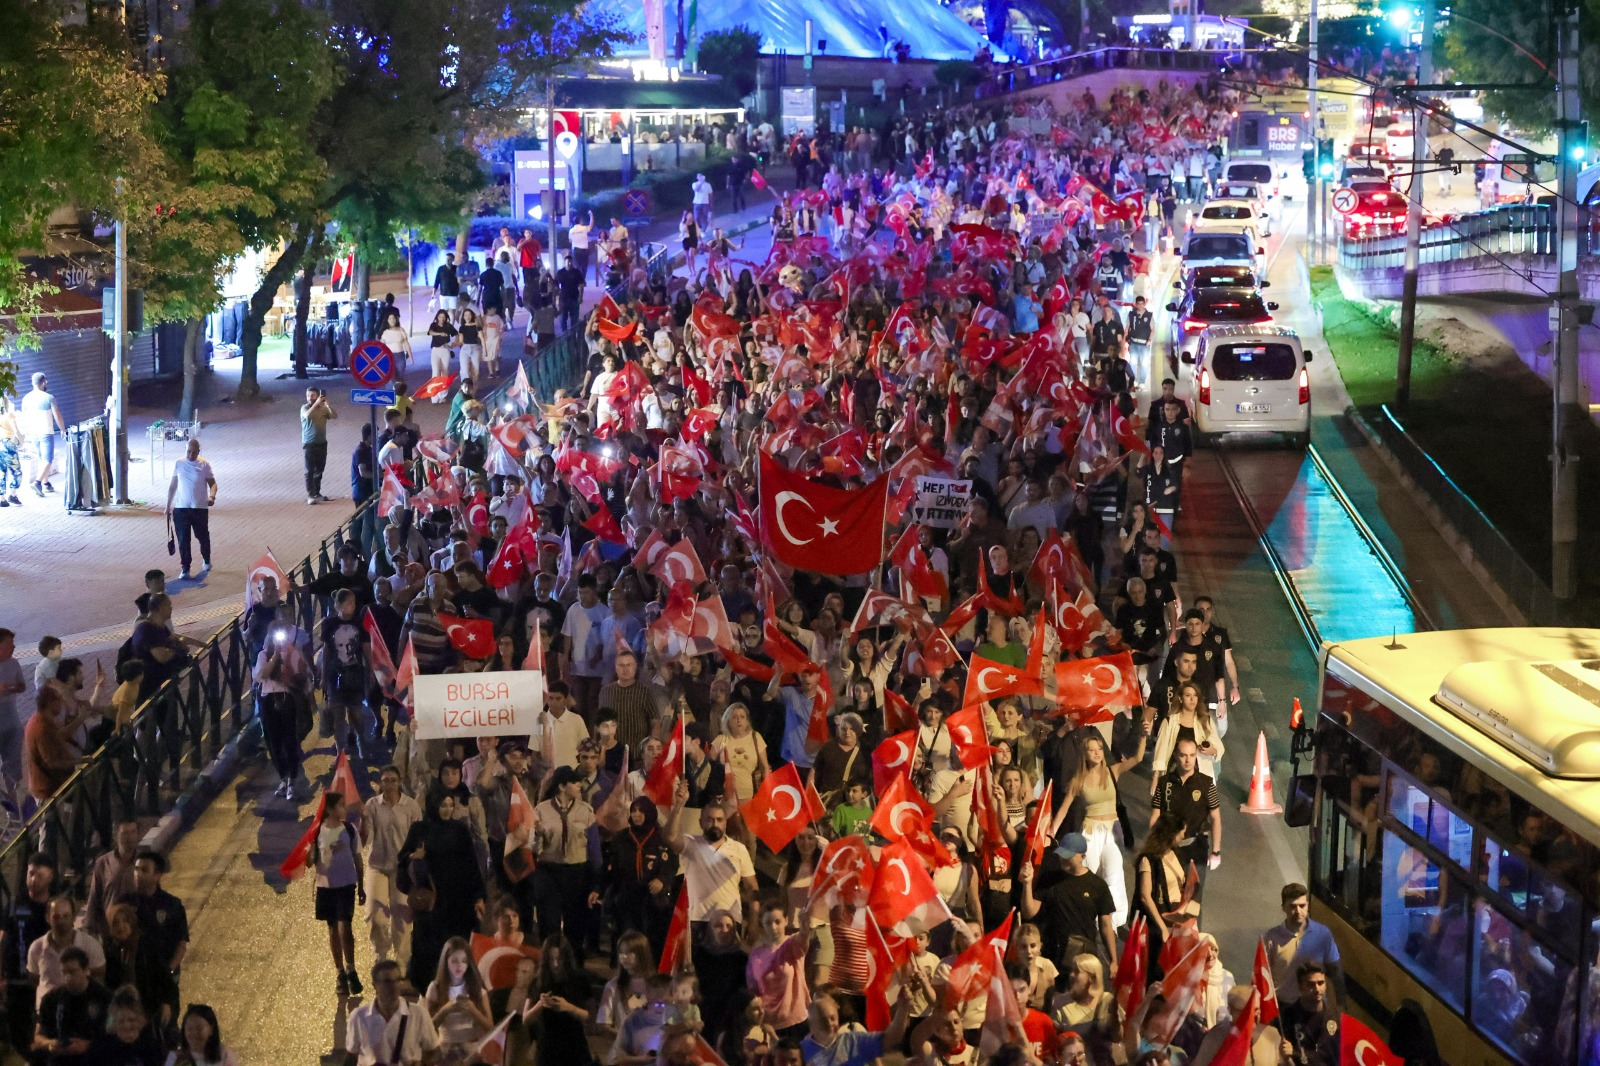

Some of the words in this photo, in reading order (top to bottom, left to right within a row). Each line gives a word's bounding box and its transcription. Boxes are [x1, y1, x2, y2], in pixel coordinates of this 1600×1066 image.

[1268, 127, 1297, 141] BRS
[1268, 142, 1296, 151] Haber
[923, 481, 945, 493] HEP
[447, 682, 509, 701] BURSA
[443, 705, 515, 728] İZCİLERİ
